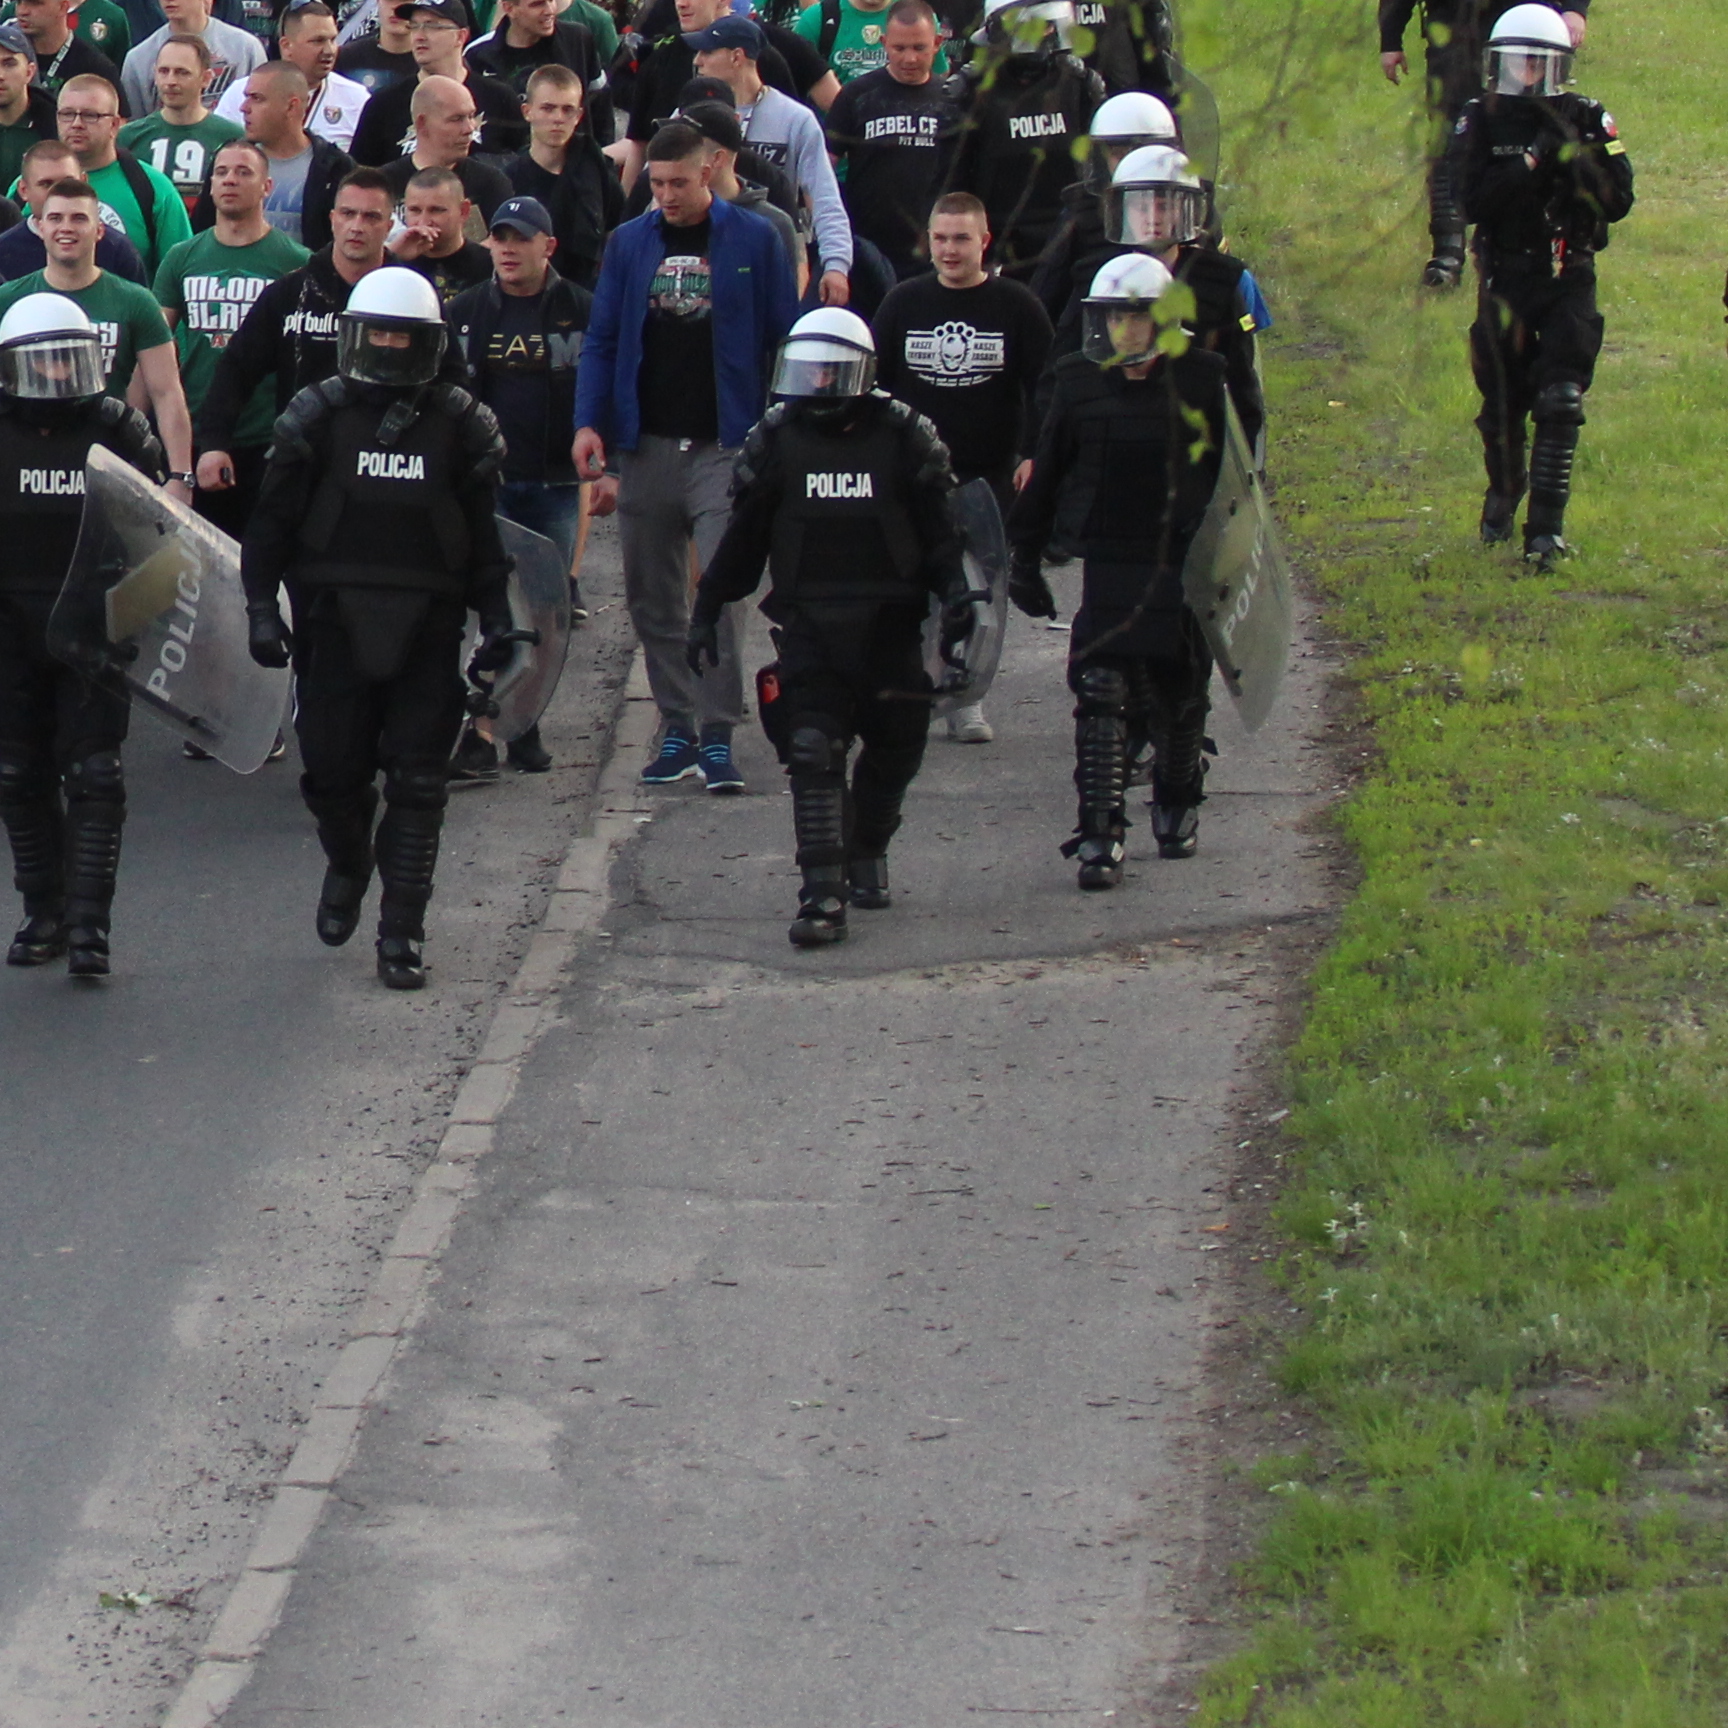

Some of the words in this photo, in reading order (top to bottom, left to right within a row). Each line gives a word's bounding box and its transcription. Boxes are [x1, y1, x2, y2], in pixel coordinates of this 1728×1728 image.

[864, 117, 916, 141] REBEL
[1010, 112, 1067, 139] POLICJA
[149, 139, 205, 184] 19
[184, 276, 276, 303] MŁOD
[356, 450, 425, 480] POLICJA
[20, 468, 85, 495] POLICJA
[806, 472, 873, 499] POLICJA
